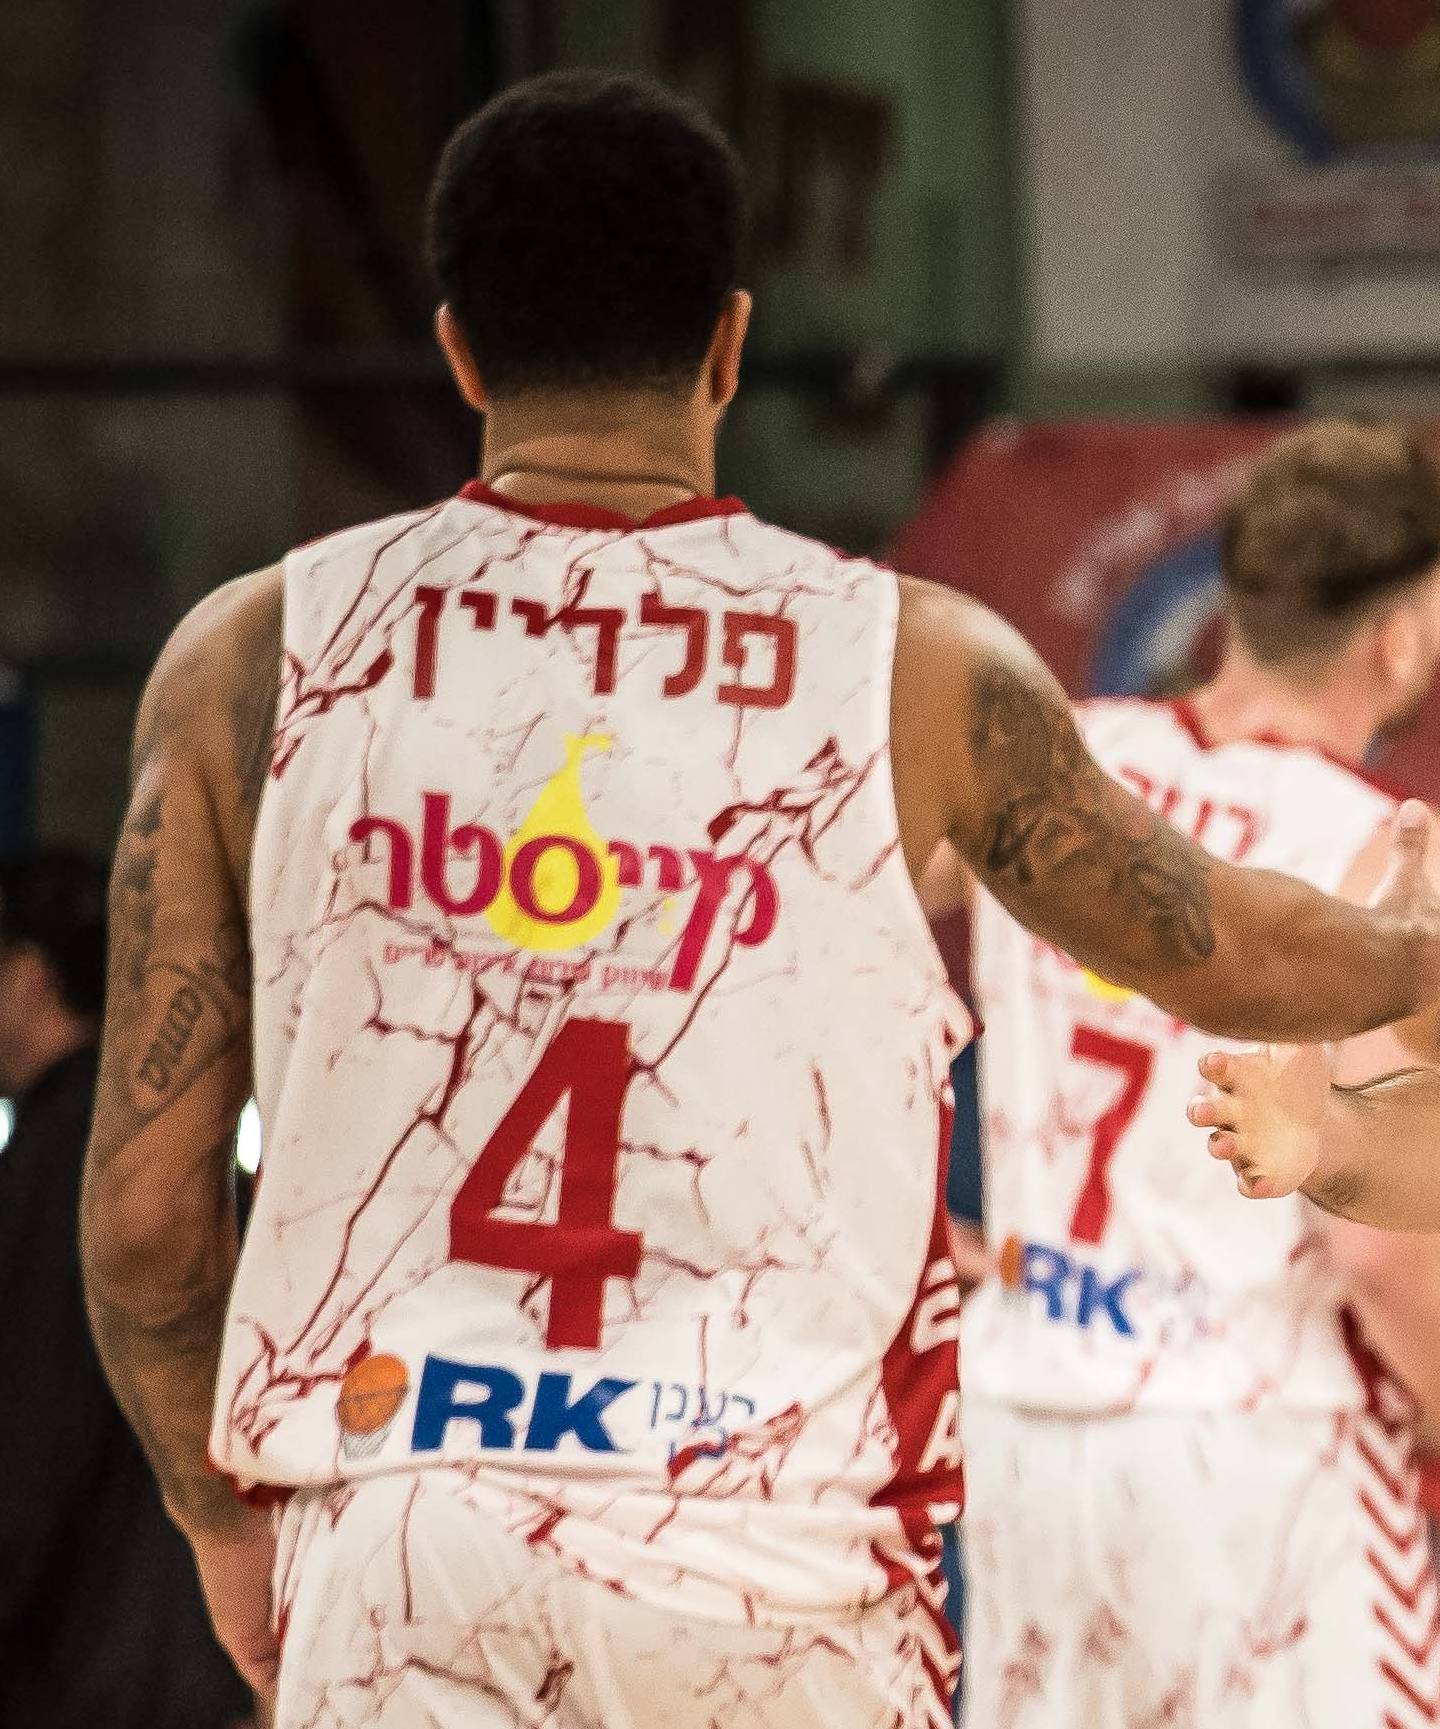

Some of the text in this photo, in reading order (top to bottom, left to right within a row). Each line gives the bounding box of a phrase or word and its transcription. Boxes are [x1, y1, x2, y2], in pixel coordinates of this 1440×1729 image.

[411, 585, 798, 707] פלדיין
[449, 1016, 642, 1348] 4
[1070, 1024, 1156, 1244] 7
[1022, 1242, 1143, 1338] RK
[410, 1353, 637, 1453] RK
